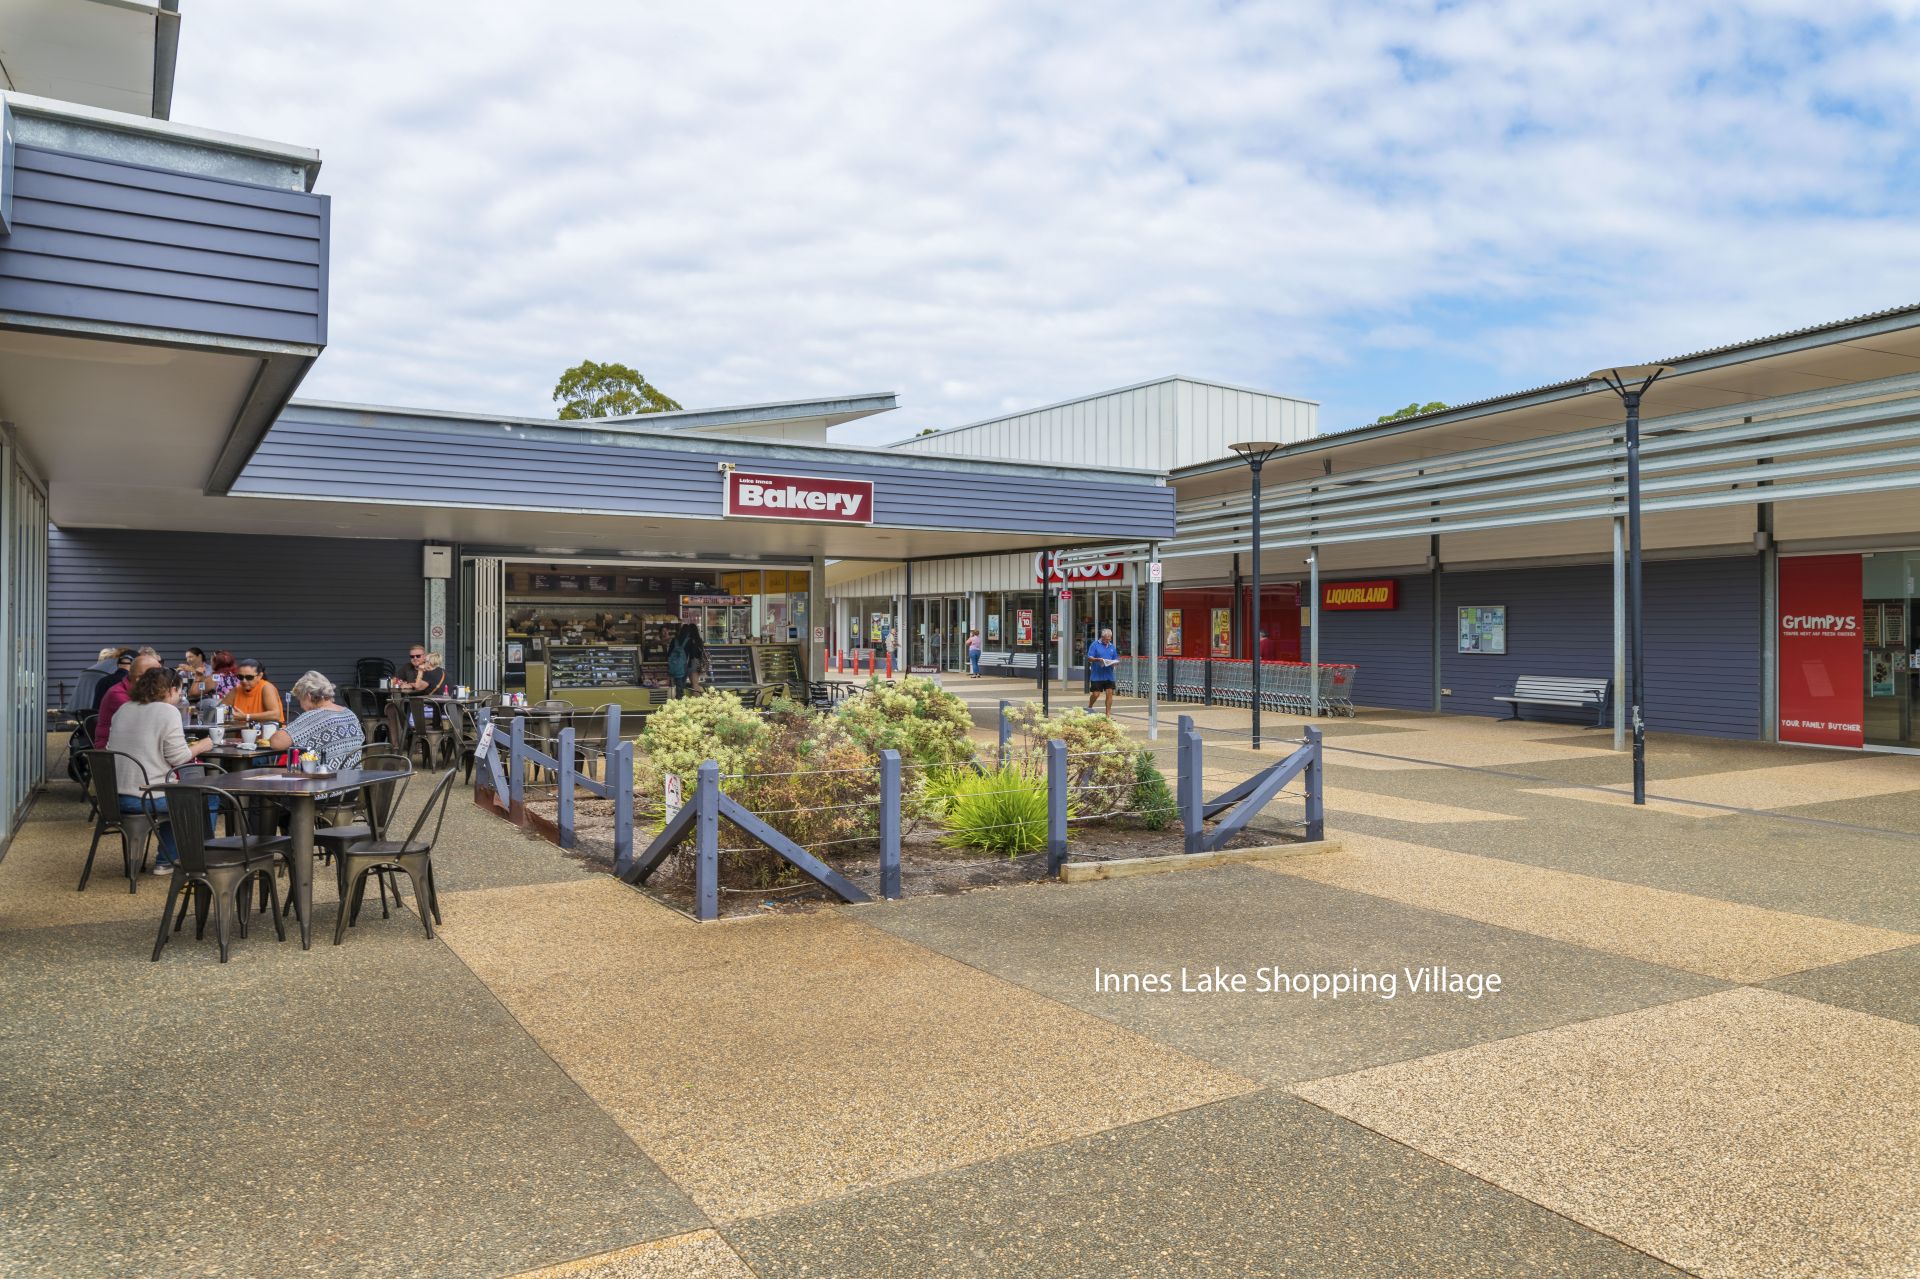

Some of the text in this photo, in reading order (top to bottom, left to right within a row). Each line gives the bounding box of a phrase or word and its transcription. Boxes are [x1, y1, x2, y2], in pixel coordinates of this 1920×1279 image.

[738, 483, 863, 516] Bakery
[1326, 587, 1389, 604] LIQUORLAND
[1781, 719, 1862, 732] YOUR FAMILY BUTCHER
